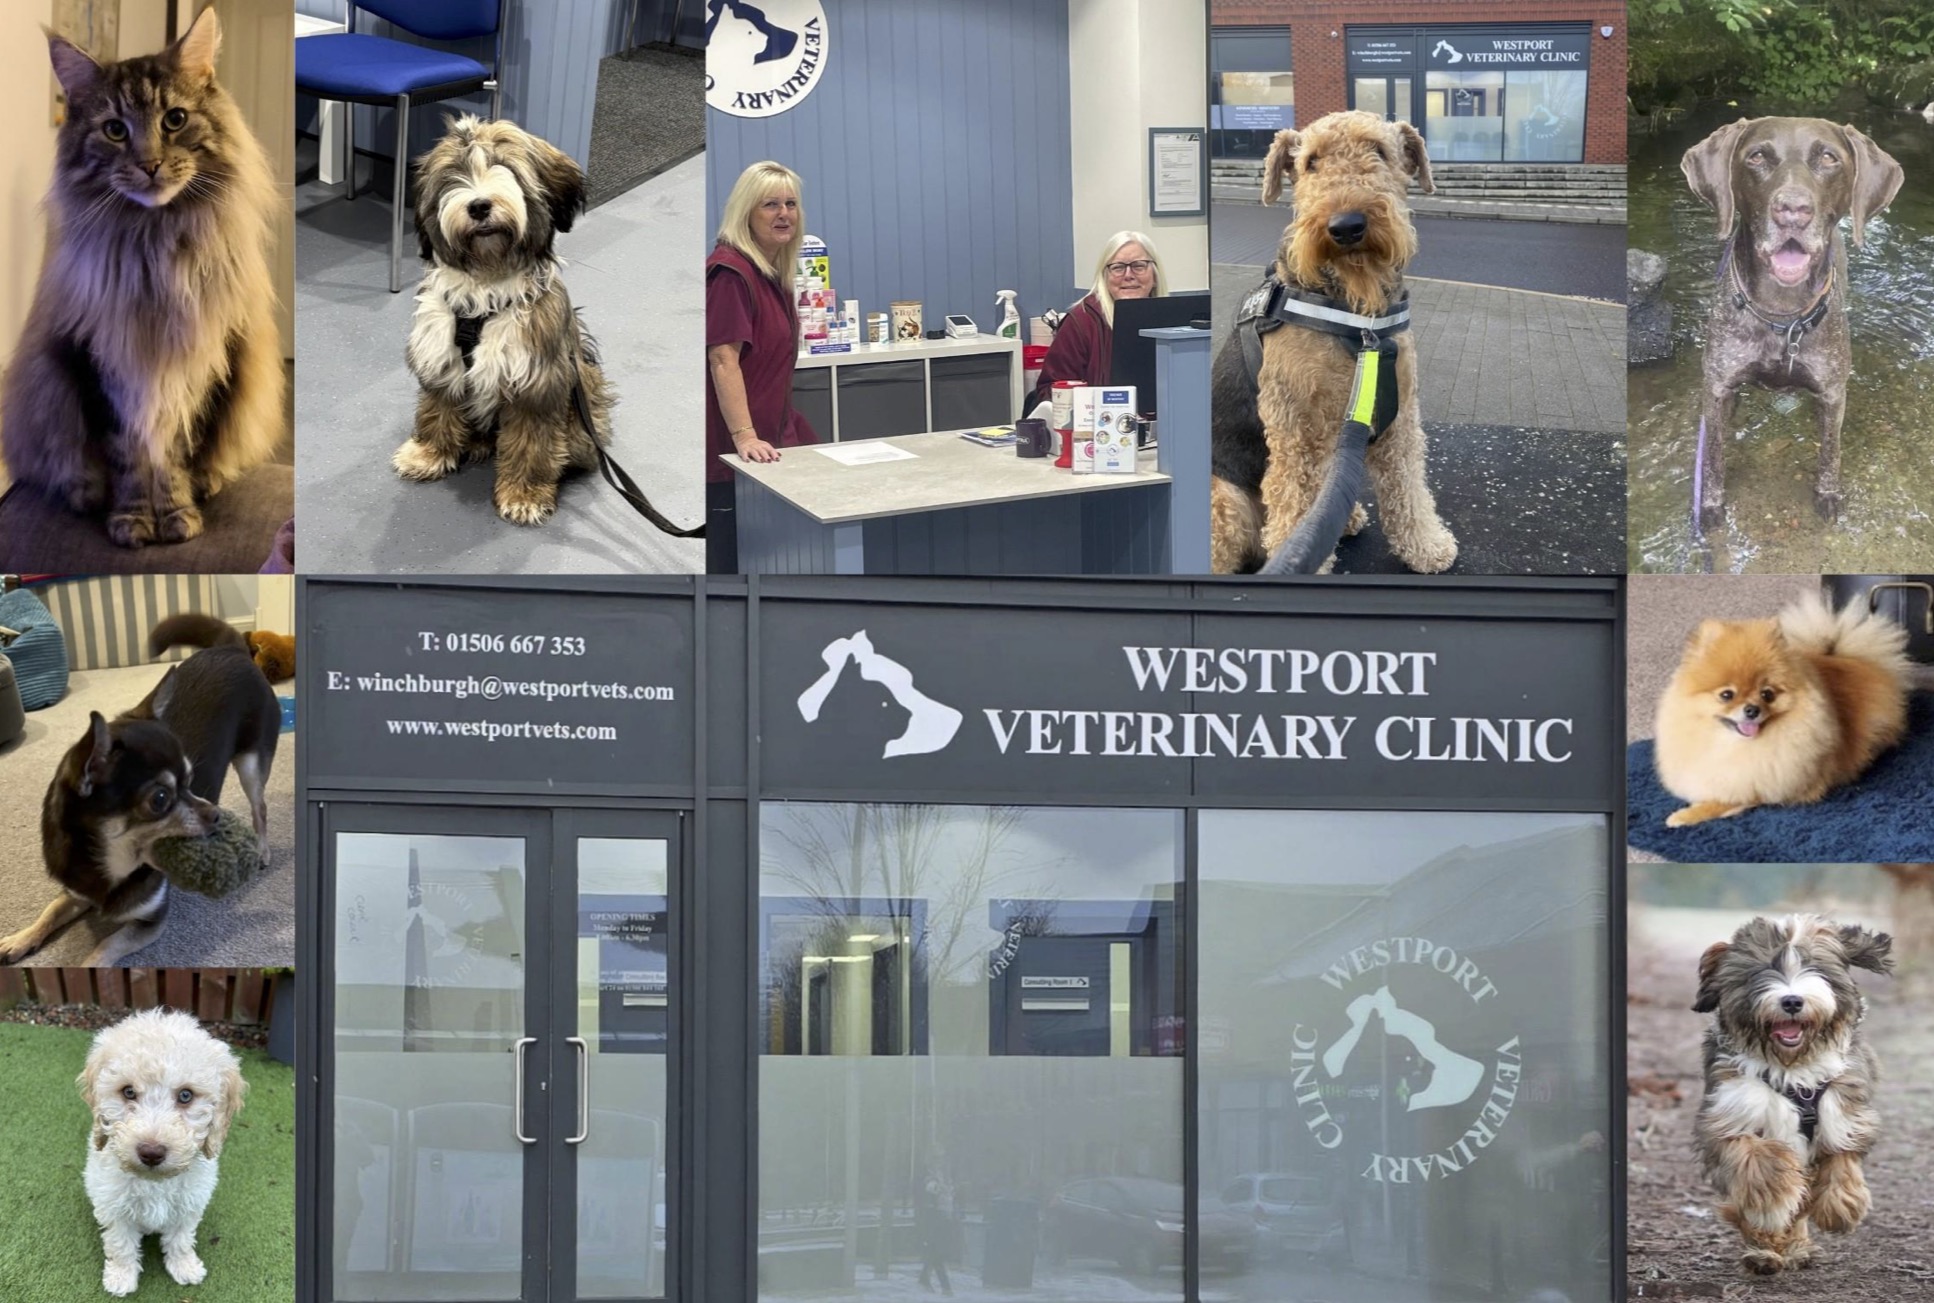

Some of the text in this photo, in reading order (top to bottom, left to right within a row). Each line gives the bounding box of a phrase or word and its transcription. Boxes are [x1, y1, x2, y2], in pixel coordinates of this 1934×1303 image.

[731, 16, 820, 109] VETERINARY
[1466, 51, 1581, 63] VETERINARY CLINIC
[1492, 39, 1555, 51] WESTPORT
[418, 631, 586, 656] T: 01506 667 353
[327, 671, 675, 702] E: winchburgh@westportvets.com
[1122, 646, 1437, 696] WESTPORT
[386, 719, 617, 742] www.westportvets.com
[982, 708, 1573, 763] VETERINARY CLINIC
[590, 912, 656, 921] OPENING TIMES
[1320, 937, 1498, 1003] WESTPORT
[1290, 1024, 1343, 1149] CLINIC
[1361, 1035, 1521, 1183] VETERINARY
